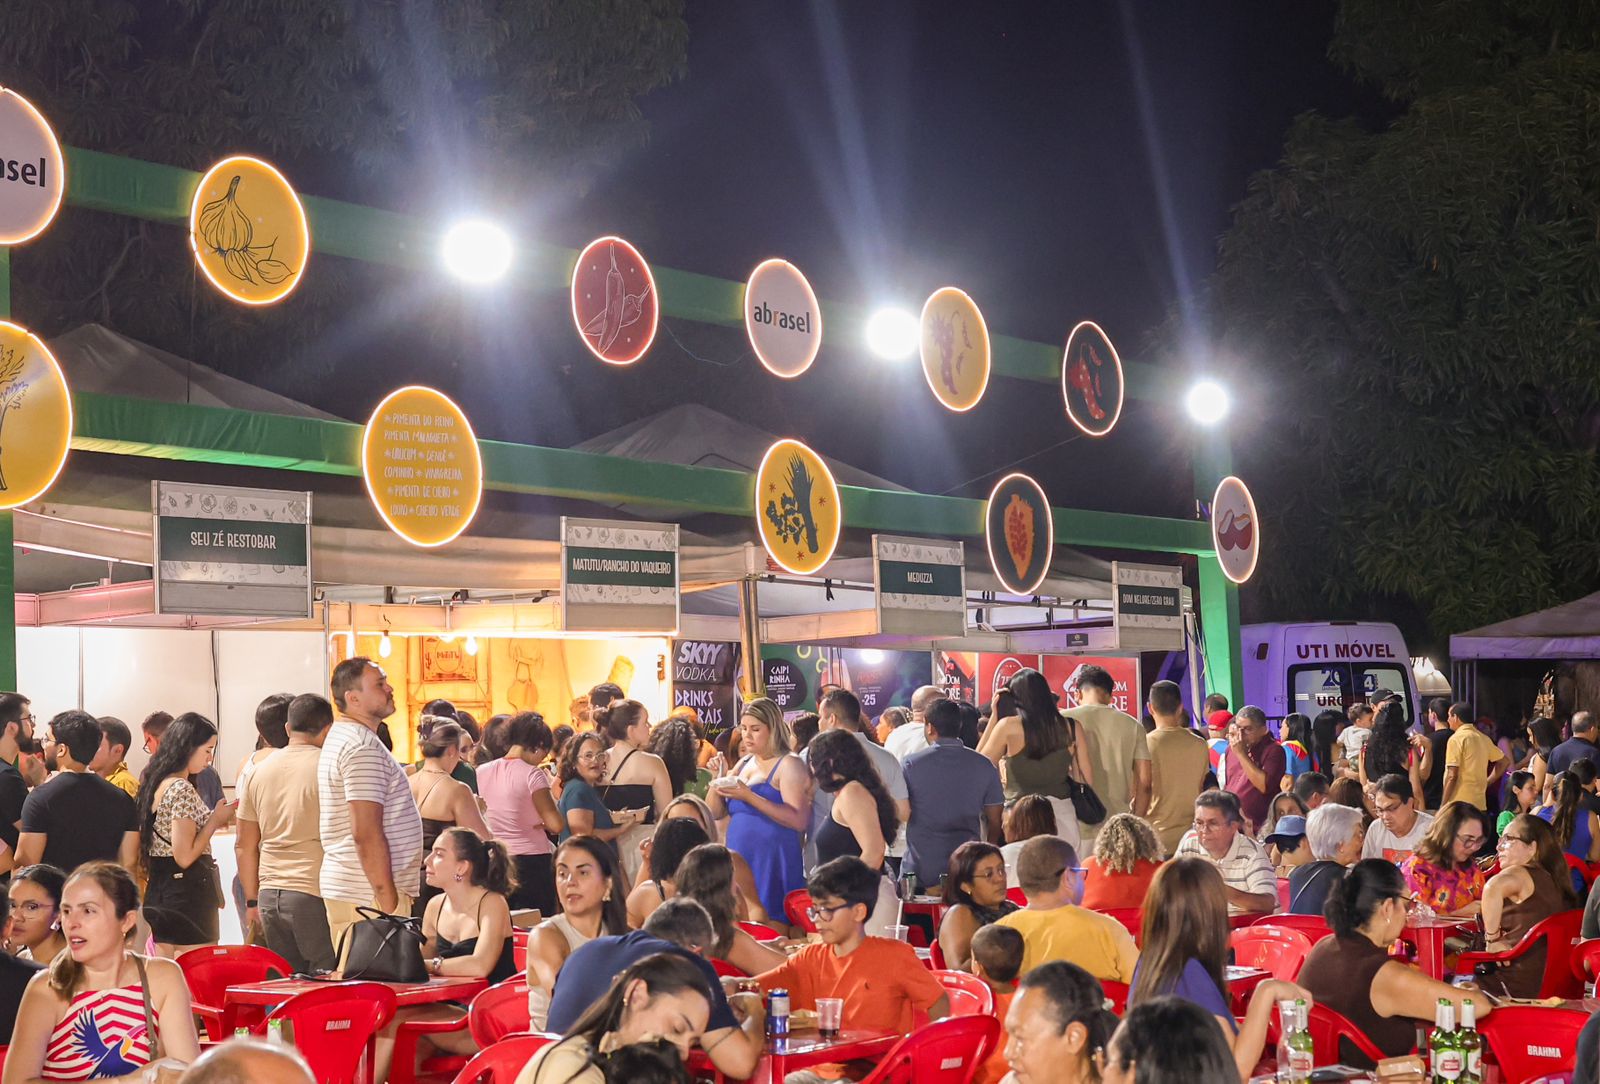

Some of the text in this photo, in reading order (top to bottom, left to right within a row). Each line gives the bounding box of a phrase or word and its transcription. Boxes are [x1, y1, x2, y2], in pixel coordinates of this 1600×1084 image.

[753, 301, 811, 334] abrasel
[190, 530, 277, 550] SEU ZÉ RESTOBAR
[572, 557, 671, 575] MATUTU/RANCHO DO VAQUEIRO
[907, 571, 934, 584] MEDUZZA
[678, 641, 723, 666] SKYY
[1297, 640, 1395, 659] UTI MÓVEL
[676, 666, 717, 682] VODKA
[770, 665, 790, 675] CAIPI
[769, 674, 791, 684] RINHA
[945, 673, 961, 686] DOM
[675, 689, 714, 707] DRINKS
[1527, 1044, 1562, 1058] BRAHMA
